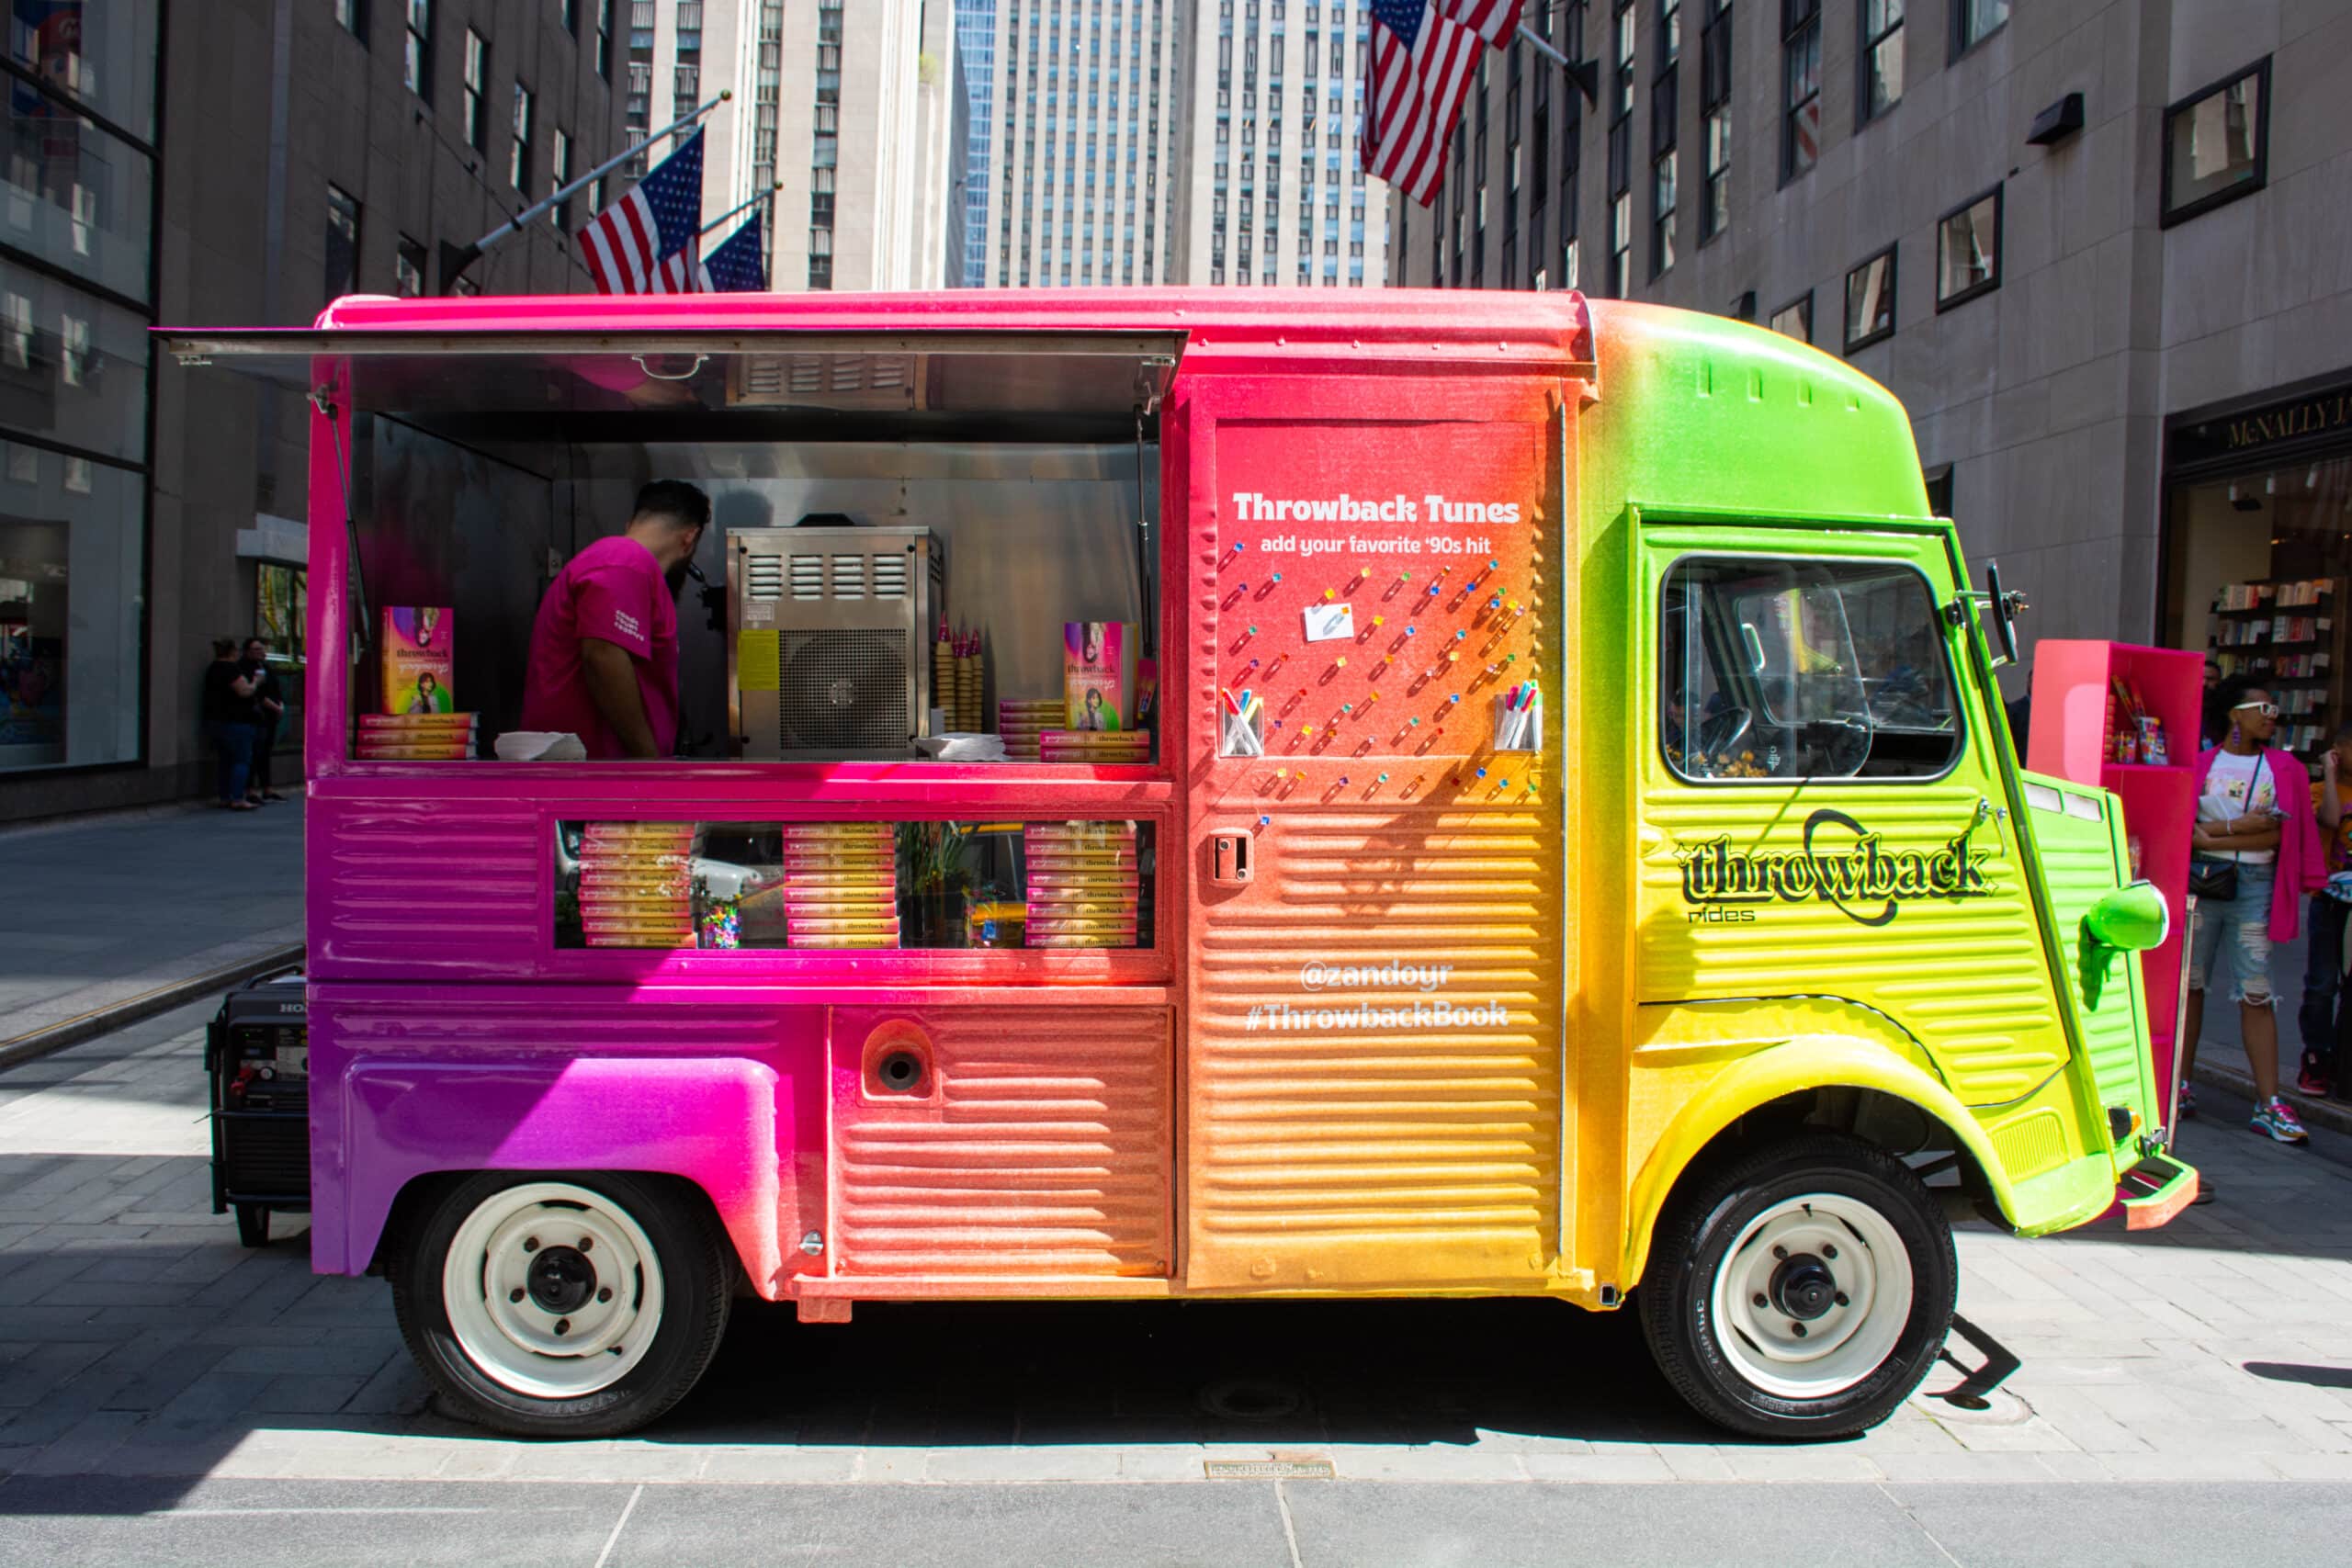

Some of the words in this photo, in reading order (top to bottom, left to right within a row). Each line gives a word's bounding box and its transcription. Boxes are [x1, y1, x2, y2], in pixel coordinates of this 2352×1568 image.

[1232, 492, 1418, 522] Throwback
[1423, 494, 1521, 524] Tunes
[1260, 535, 1296, 553] add
[1300, 538, 1345, 557] your
[1349, 536, 1421, 554] favorite
[1465, 537, 1491, 555] hit
[1681, 829, 1991, 906] throwback
[1688, 908, 1756, 923] rides
[1300, 959, 1453, 992] @zandoyr
[279, 1003, 305, 1012] HO
[1245, 999, 1509, 1031] #ThrowbackBook
